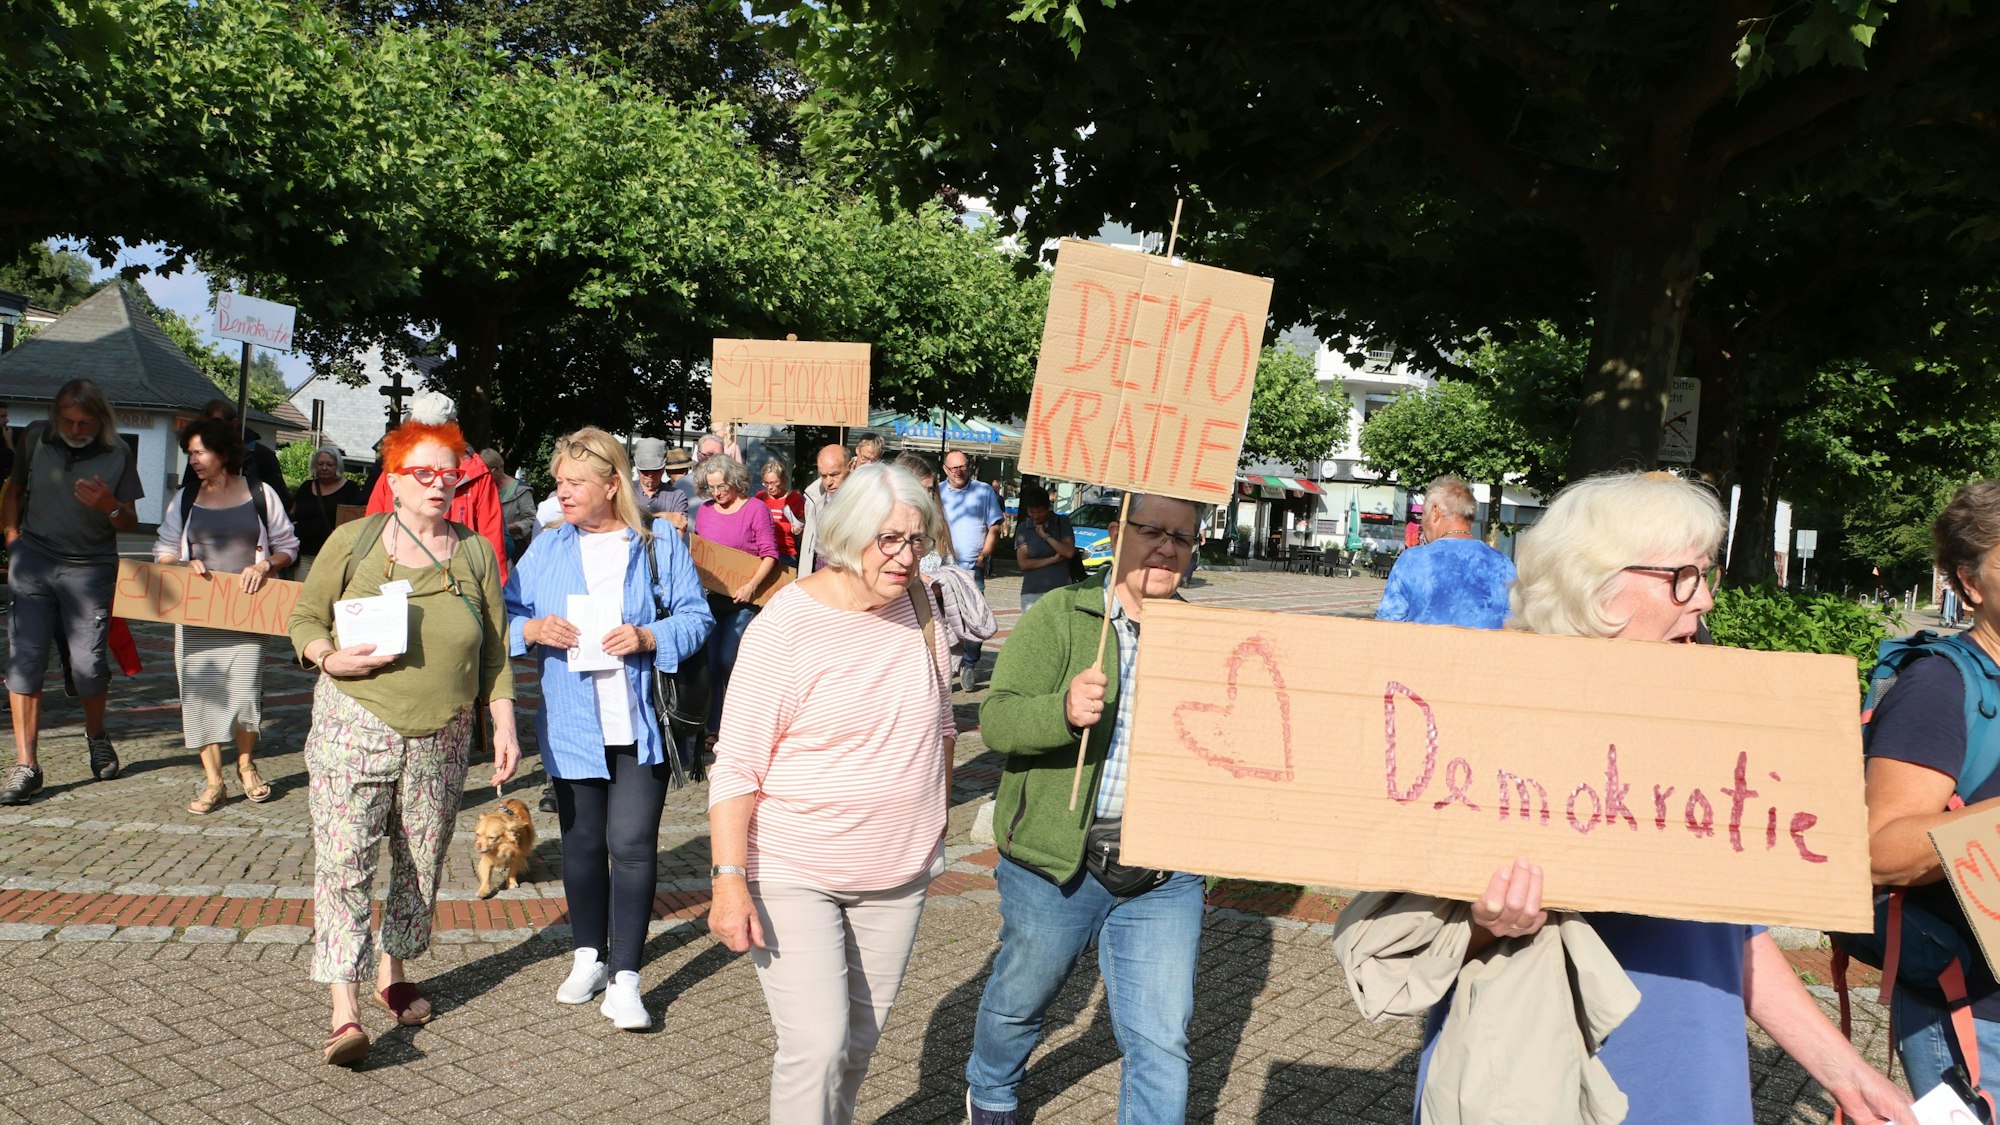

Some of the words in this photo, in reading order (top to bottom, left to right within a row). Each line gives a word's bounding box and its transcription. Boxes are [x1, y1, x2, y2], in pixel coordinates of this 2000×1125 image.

[1064, 280, 1250, 405] DEMO
[1673, 381, 1694, 391] bitte
[749, 357, 868, 426] DEMOKRATIE
[893, 418, 1004, 444] Volksbank
[1030, 384, 1240, 494] KRATIE
[1384, 680, 1828, 864] Demokratie
